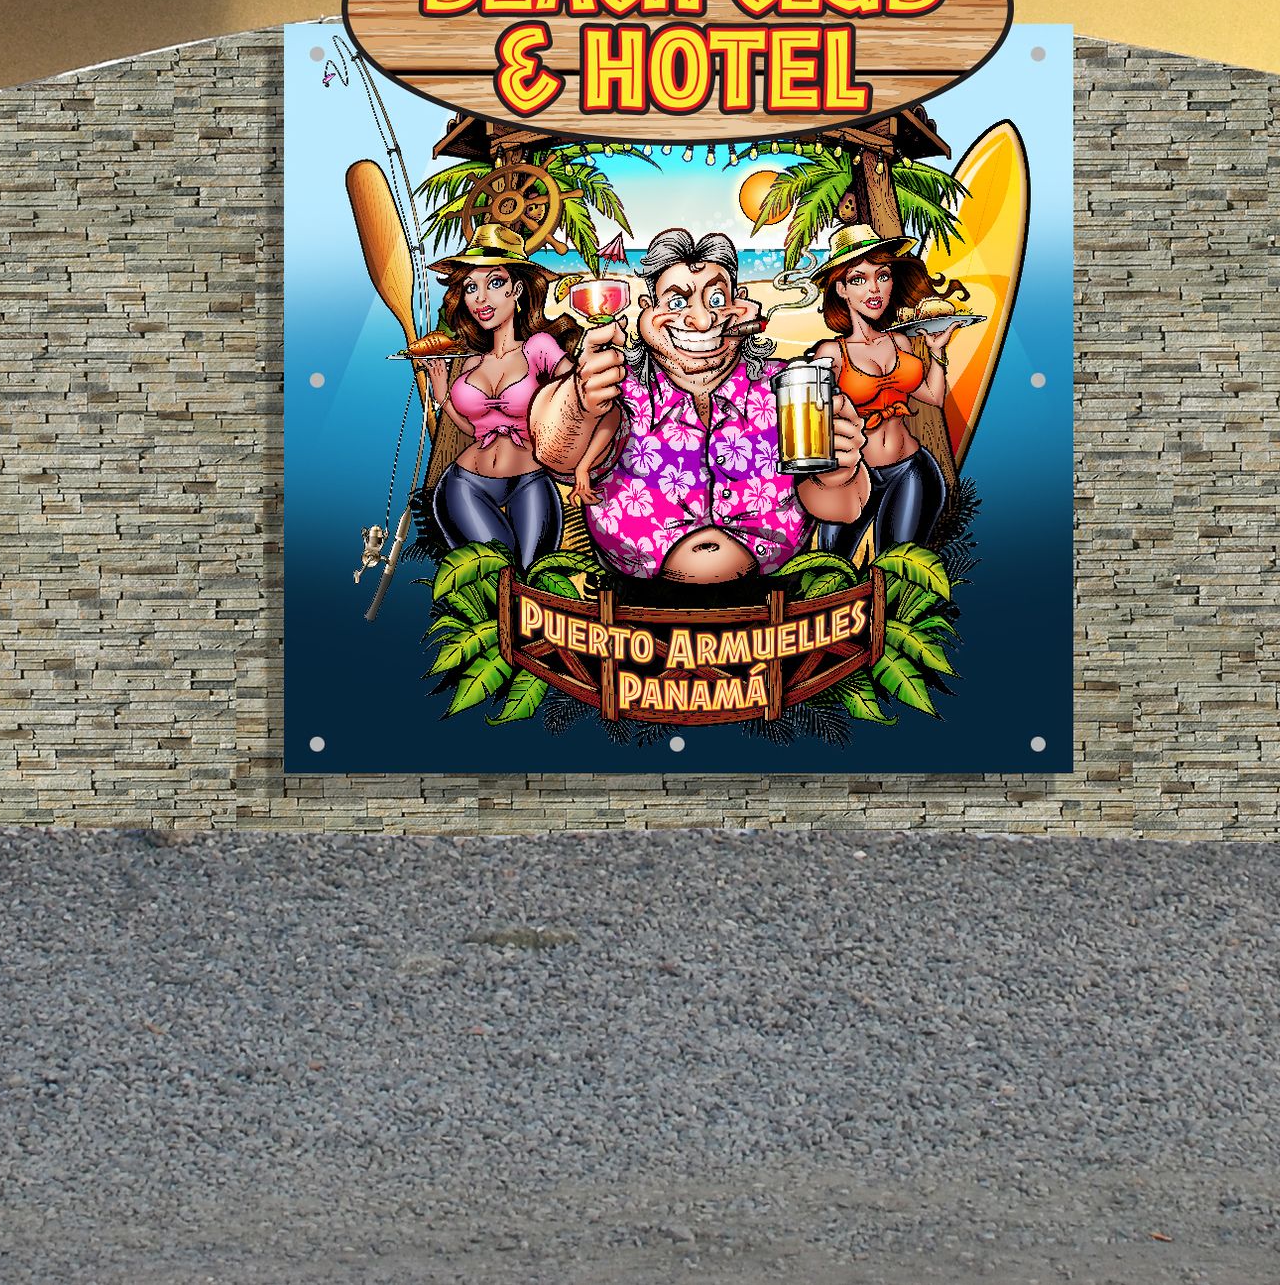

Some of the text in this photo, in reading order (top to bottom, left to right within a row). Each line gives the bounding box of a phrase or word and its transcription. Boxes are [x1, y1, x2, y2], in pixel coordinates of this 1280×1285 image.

[494, 22, 873, 116] & HOTEL
[521, 595, 866, 669] PUERTO ARMUELLES
[619, 665, 767, 711] PANAMÁ
